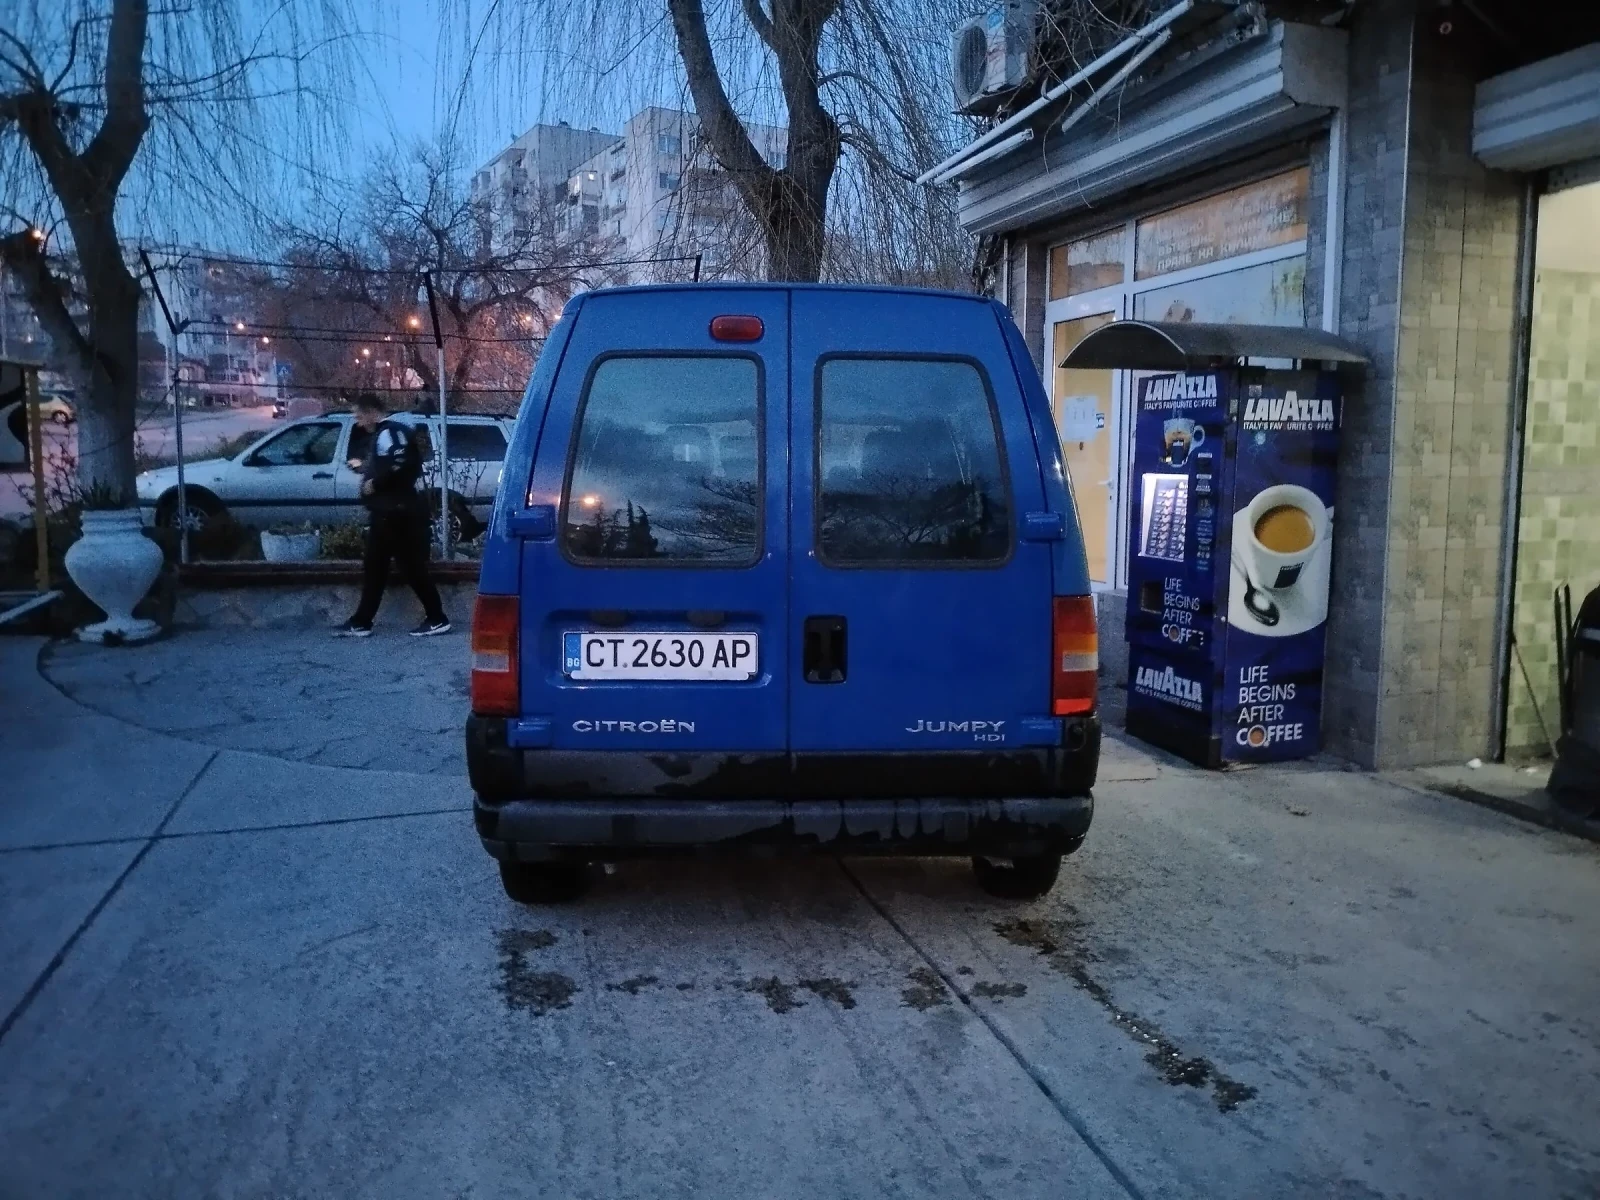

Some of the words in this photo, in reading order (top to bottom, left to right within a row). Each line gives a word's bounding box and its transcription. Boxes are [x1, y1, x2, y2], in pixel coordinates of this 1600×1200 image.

[1198, 246, 1214, 259] НА
[1144, 373, 1217, 402] LAVAZZA
[1193, 399, 1217, 409] CFFEE
[1243, 390, 1334, 421] LAVAZZA
[1269, 422, 1307, 431] FAVURITE
[1307, 422, 1334, 431] CFFEE
[1164, 577, 1182, 592] LIFE
[1163, 592, 1200, 611] BEGINS
[1162, 608, 1192, 625] AFTER
[1161, 623, 1204, 646] COFF
[566, 657, 580, 668] BG
[586, 639, 624, 667] CT
[632, 639, 704, 668] 2630
[712, 639, 751, 668] AP
[1135, 665, 1203, 703] LAVAZZA
[1240, 665, 1269, 684] LIFE
[1238, 683, 1296, 704] BEGINS
[1237, 703, 1284, 724] AFTER
[572, 719, 695, 733] CITROËN
[905, 719, 1006, 733] JUMPY
[1236, 723, 1303, 748] COFFEE
[974, 734, 1006, 742] HDI
